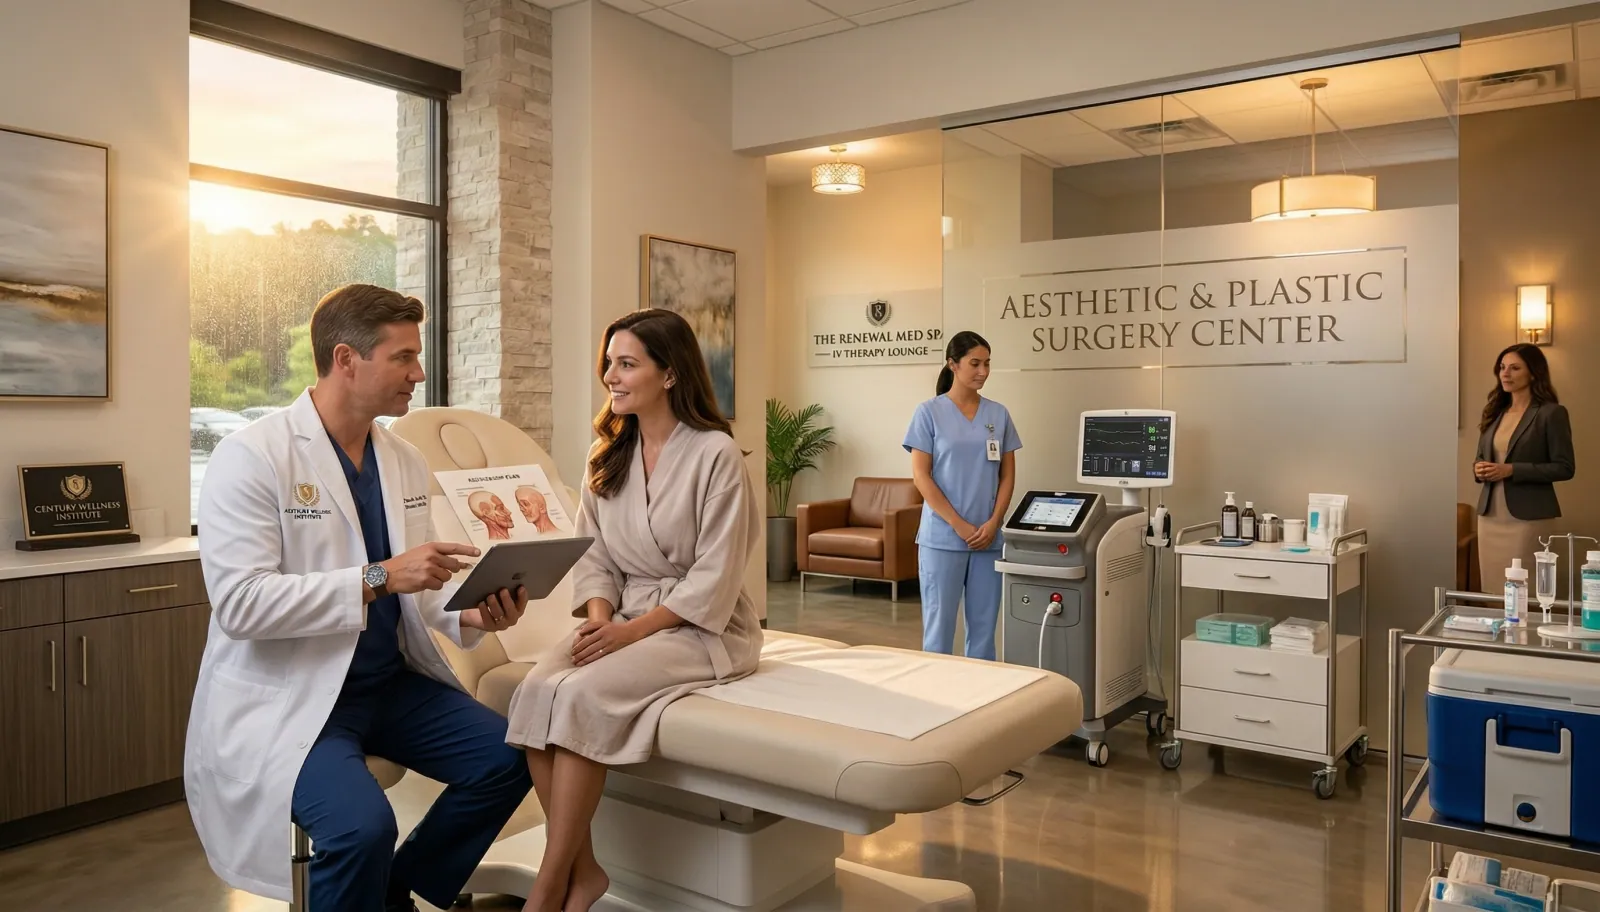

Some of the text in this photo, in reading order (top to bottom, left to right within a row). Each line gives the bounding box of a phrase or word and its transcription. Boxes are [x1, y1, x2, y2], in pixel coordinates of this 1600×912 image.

[1000, 271, 1383, 320] AESTHETIC & PLASTIC
[814, 334, 836, 345] THE
[839, 332, 893, 344] RENEWAL
[896, 330, 924, 342] MED
[1031, 314, 1344, 353] SURGERY CENTER
[832, 346, 928, 358] IV THERAPY LOUNGE
[34, 501, 121, 513] CENTURY WELLNESS
[56, 511, 101, 521] INSTITUTE
